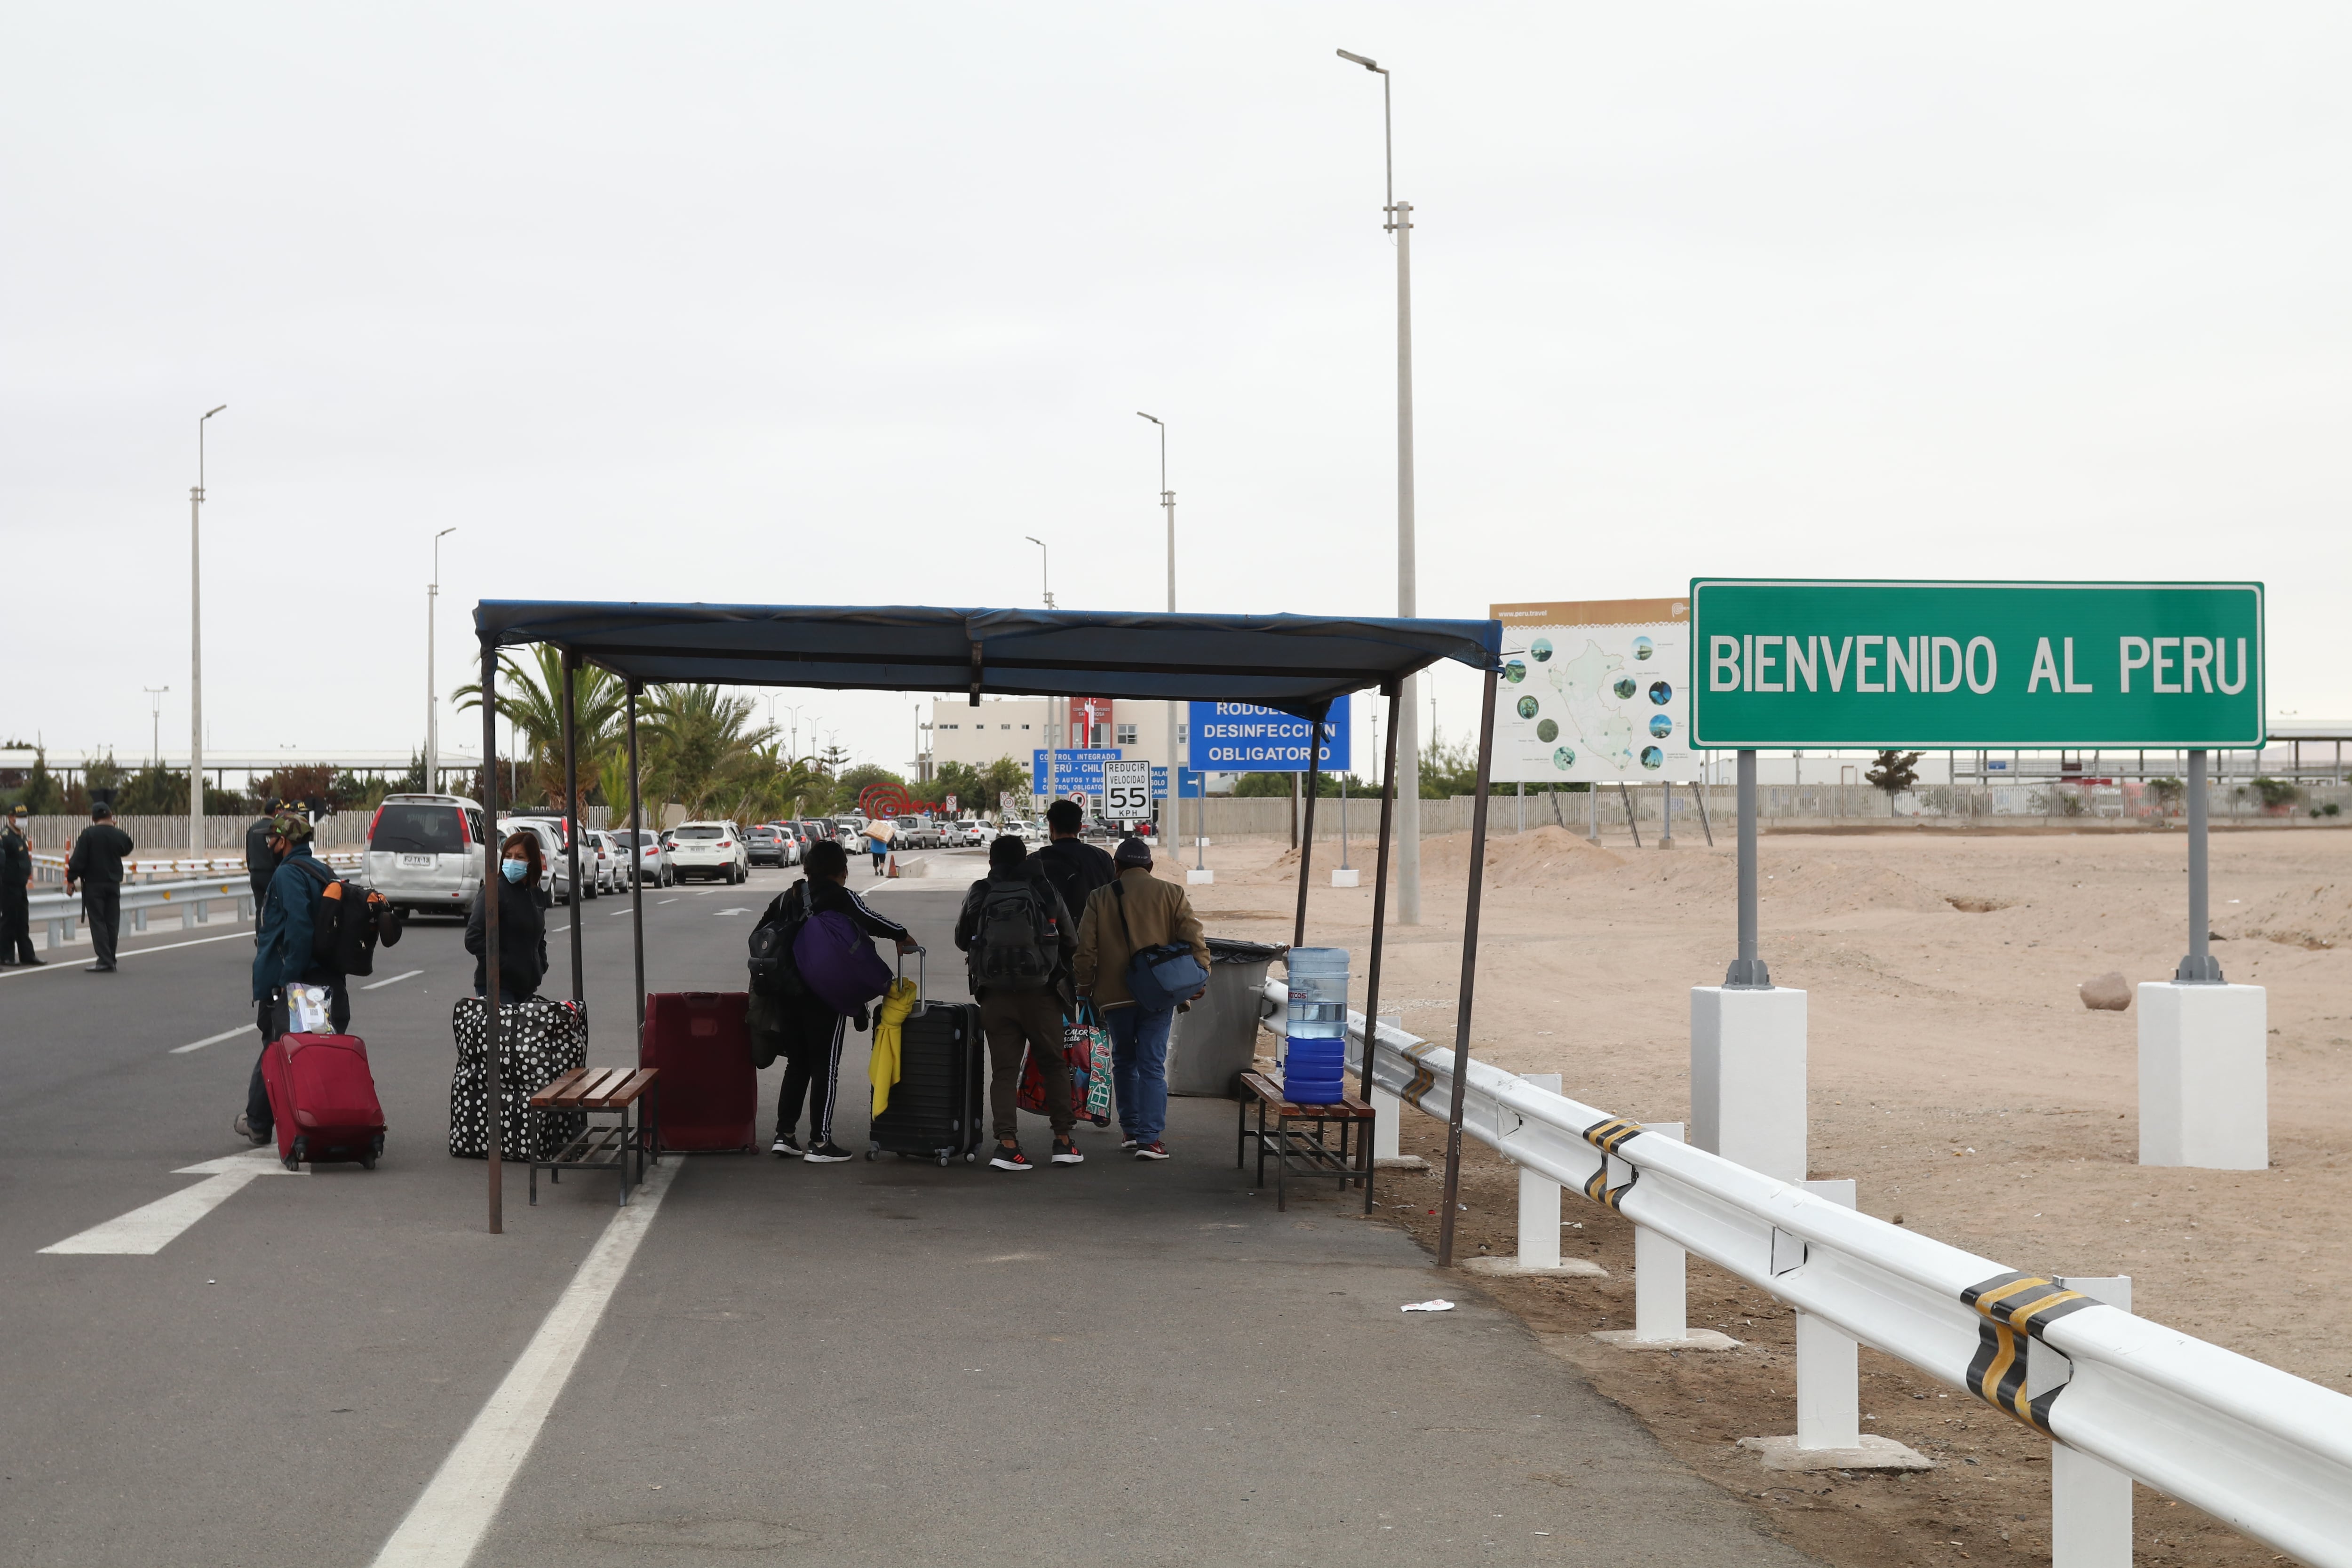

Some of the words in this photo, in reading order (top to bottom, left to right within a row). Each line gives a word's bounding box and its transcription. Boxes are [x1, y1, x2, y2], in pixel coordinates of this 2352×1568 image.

[1709, 635, 1997, 695] BIENVENIDO
[2027, 637, 2093, 694] AL
[2120, 636, 2247, 695] PERU
[1216, 702, 1289, 715] RODOL
[1204, 724, 1335, 738] DESINFECCIN
[1208, 747, 1331, 761] OBLIGATORO
[1055, 762, 1072, 772] ERÚ
[1109, 763, 1145, 772] REDUCIR
[1110, 775, 1145, 784] VELOCIDAD
[1110, 788, 1146, 808] 55
[1064, 1028, 1089, 1037] CALOR
